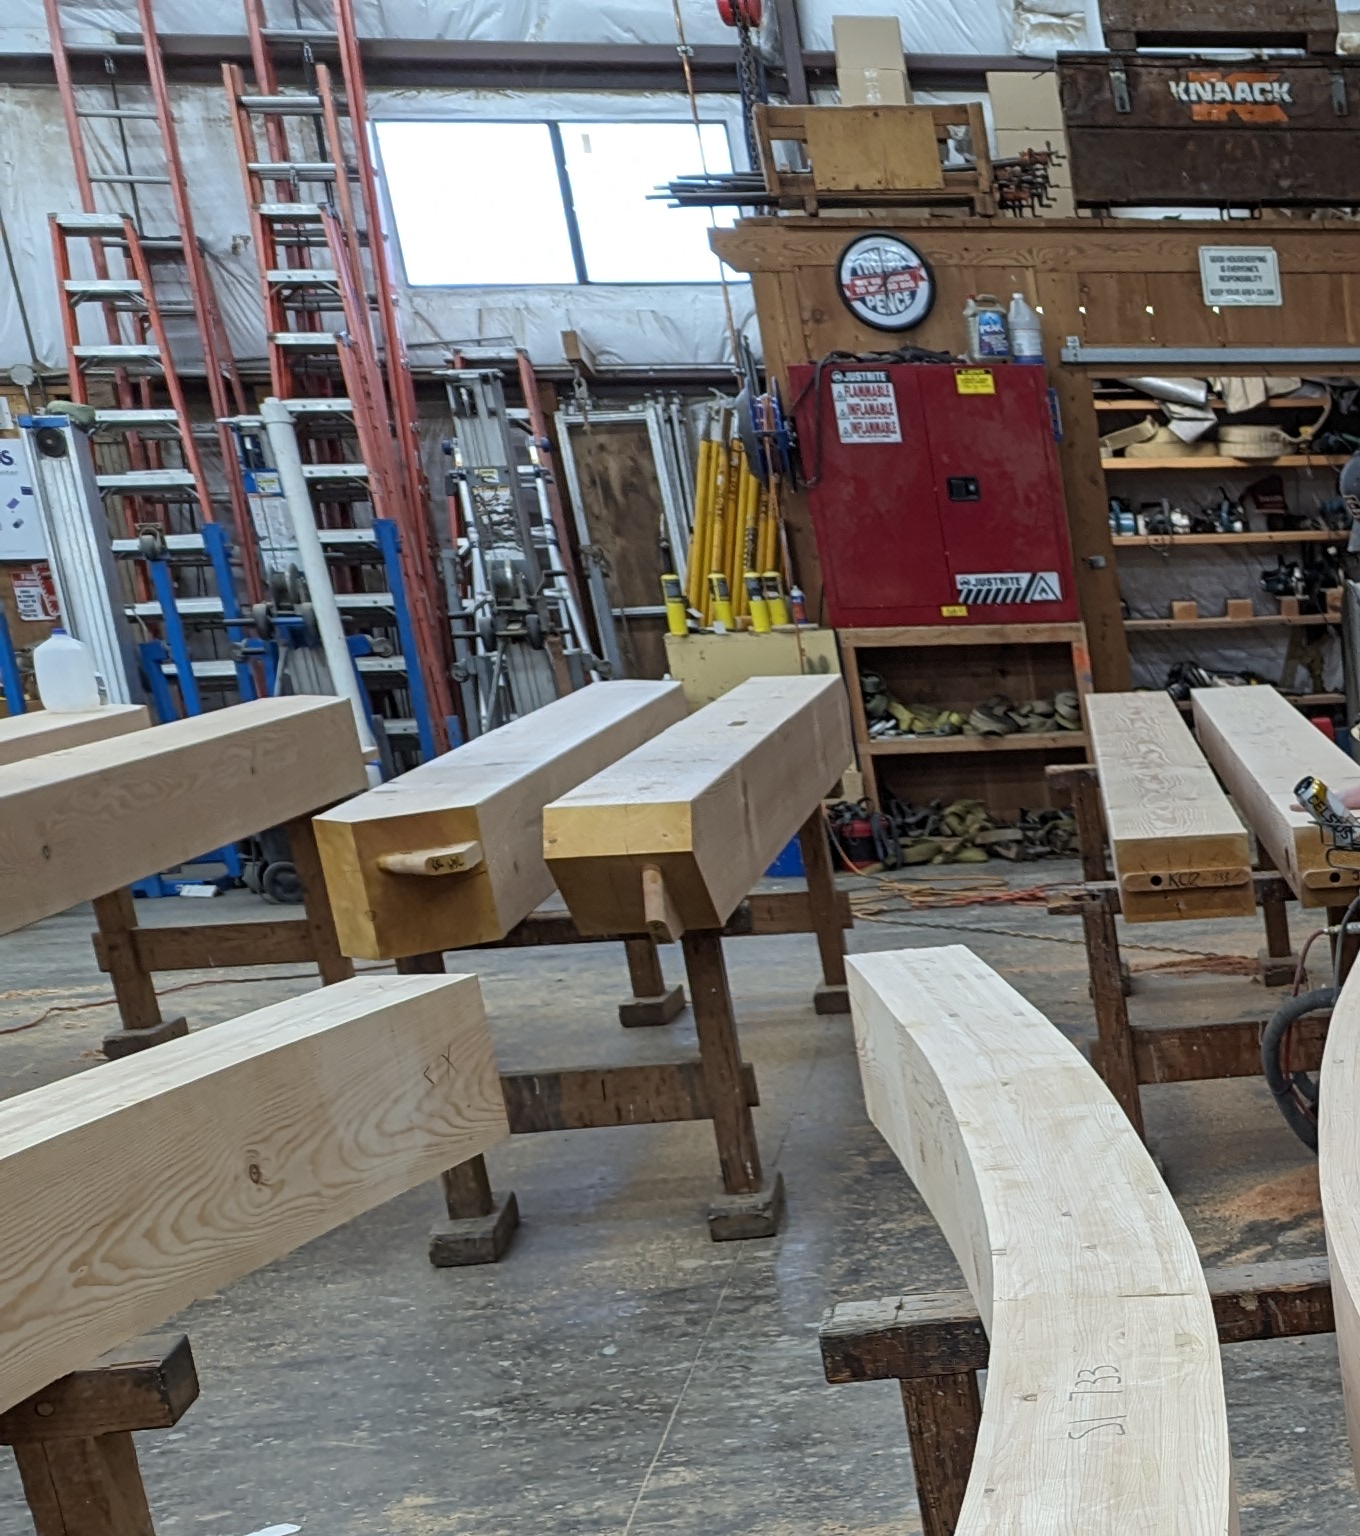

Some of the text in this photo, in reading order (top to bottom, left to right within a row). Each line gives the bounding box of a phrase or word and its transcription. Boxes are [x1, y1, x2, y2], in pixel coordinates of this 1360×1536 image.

[1168, 80, 1293, 102] KNAACK
[865, 291, 912, 314] PENCE
[842, 371, 887, 381] JUSTRITE
[844, 384, 891, 398] FLAMMABLE
[972, 577, 1021, 587] JUSTRITE
[1069, 1365, 1124, 1402] 733
